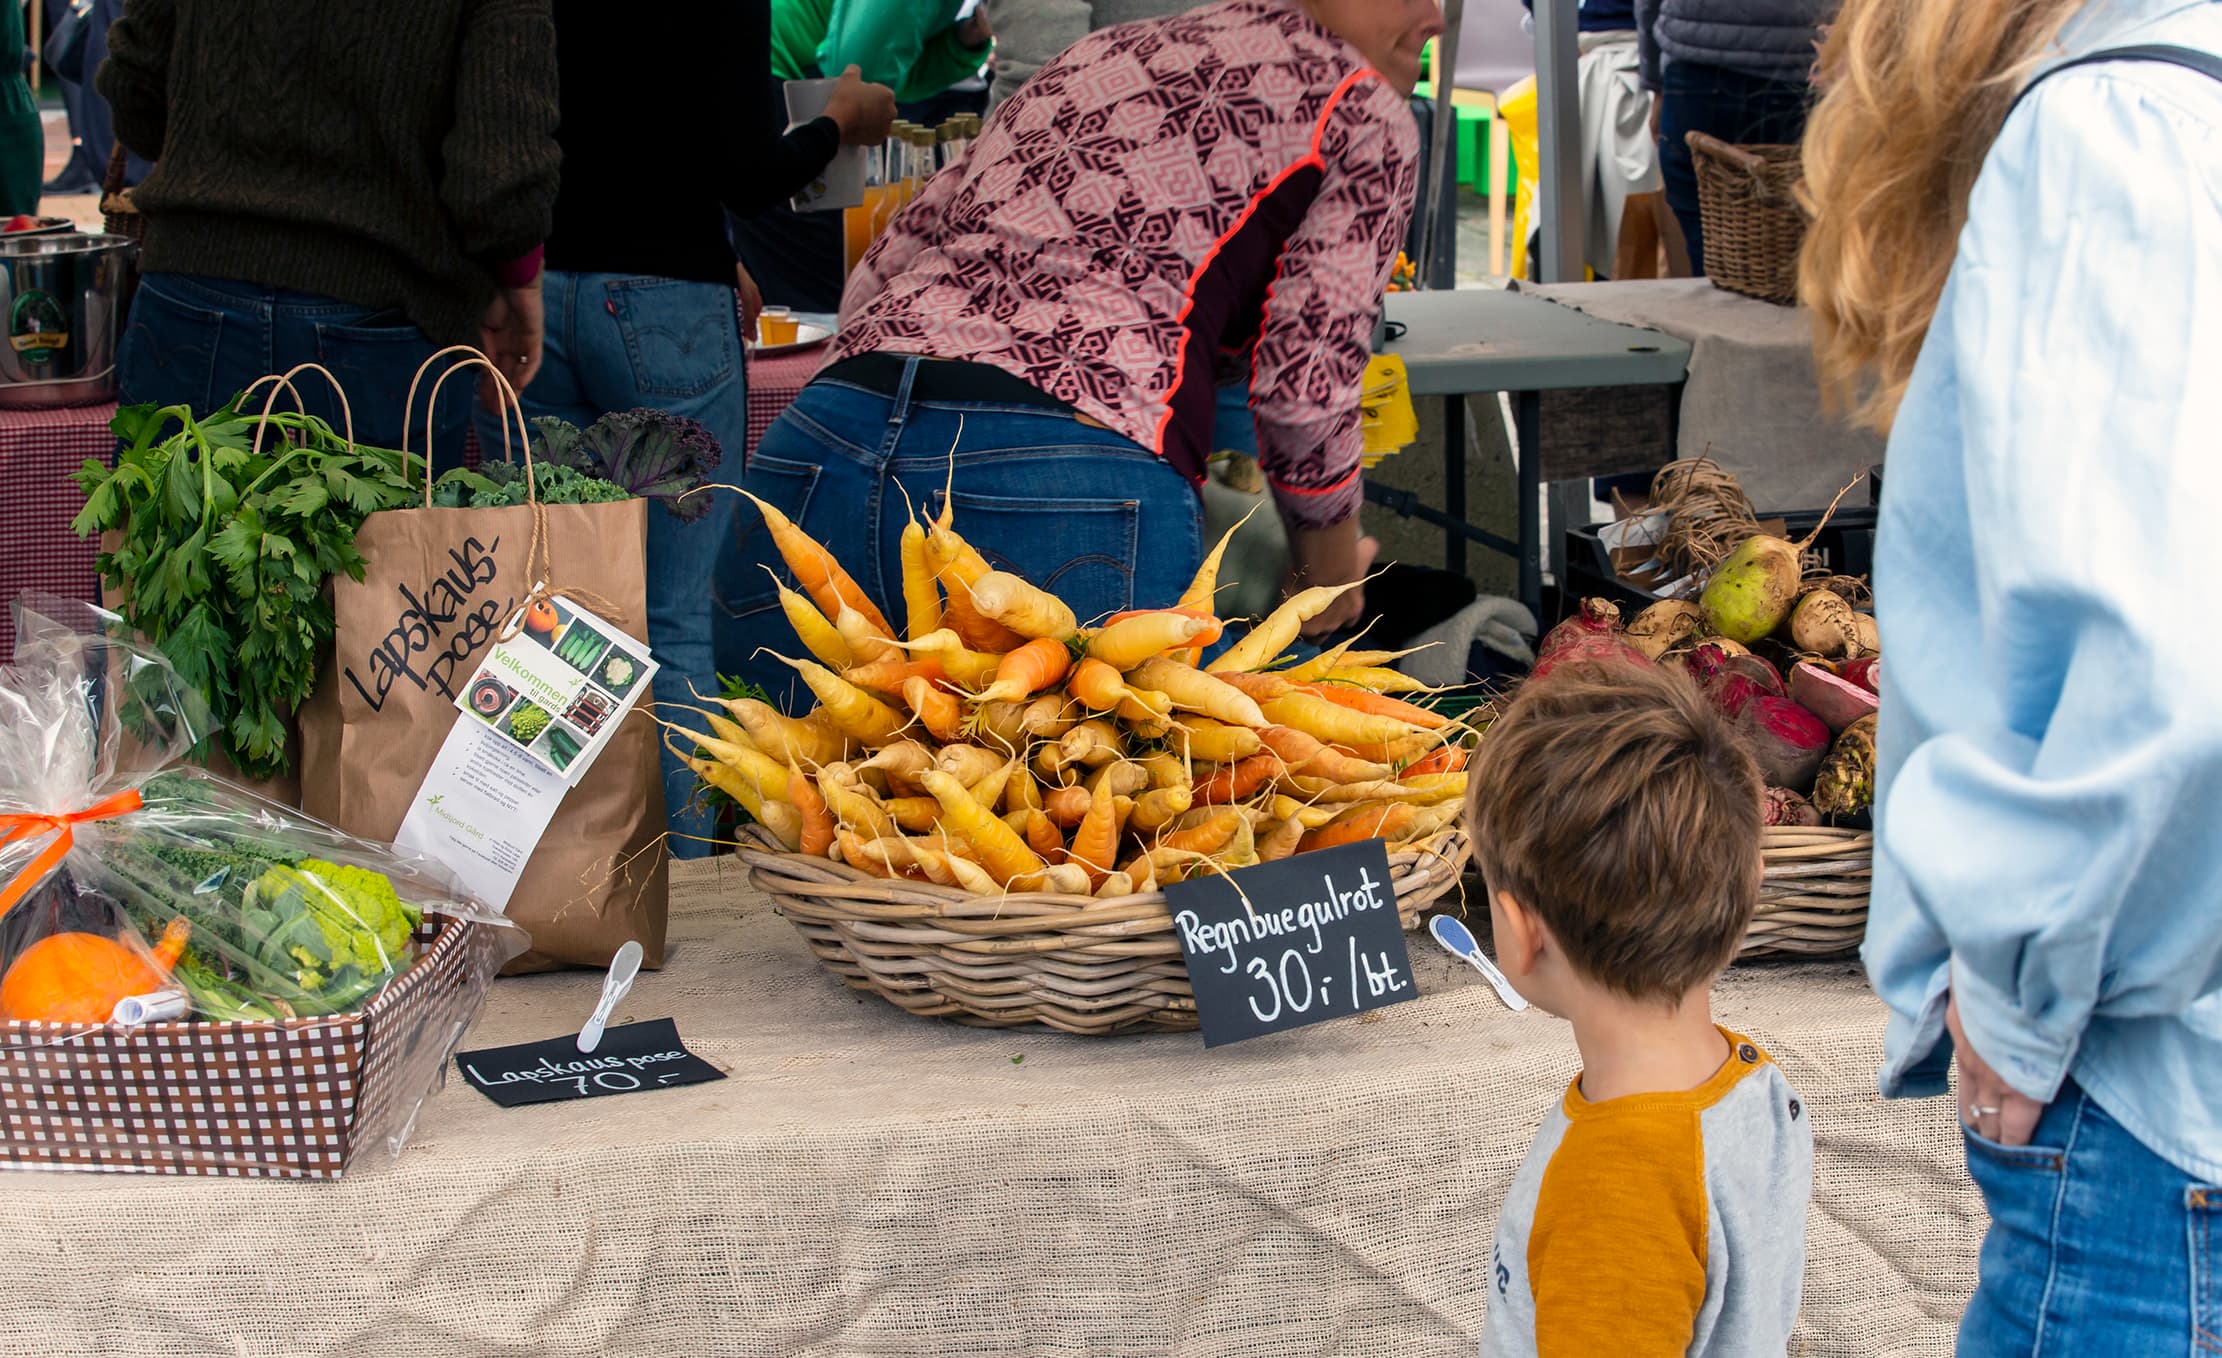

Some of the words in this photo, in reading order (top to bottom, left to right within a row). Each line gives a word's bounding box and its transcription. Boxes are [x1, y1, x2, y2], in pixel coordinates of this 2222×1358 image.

[494, 646, 569, 706] Velkommen
[529, 688, 538, 698] til
[537, 694, 561, 713] gards
[467, 1056, 625, 1087] Lapskaus
[625, 1050, 688, 1070] pose
